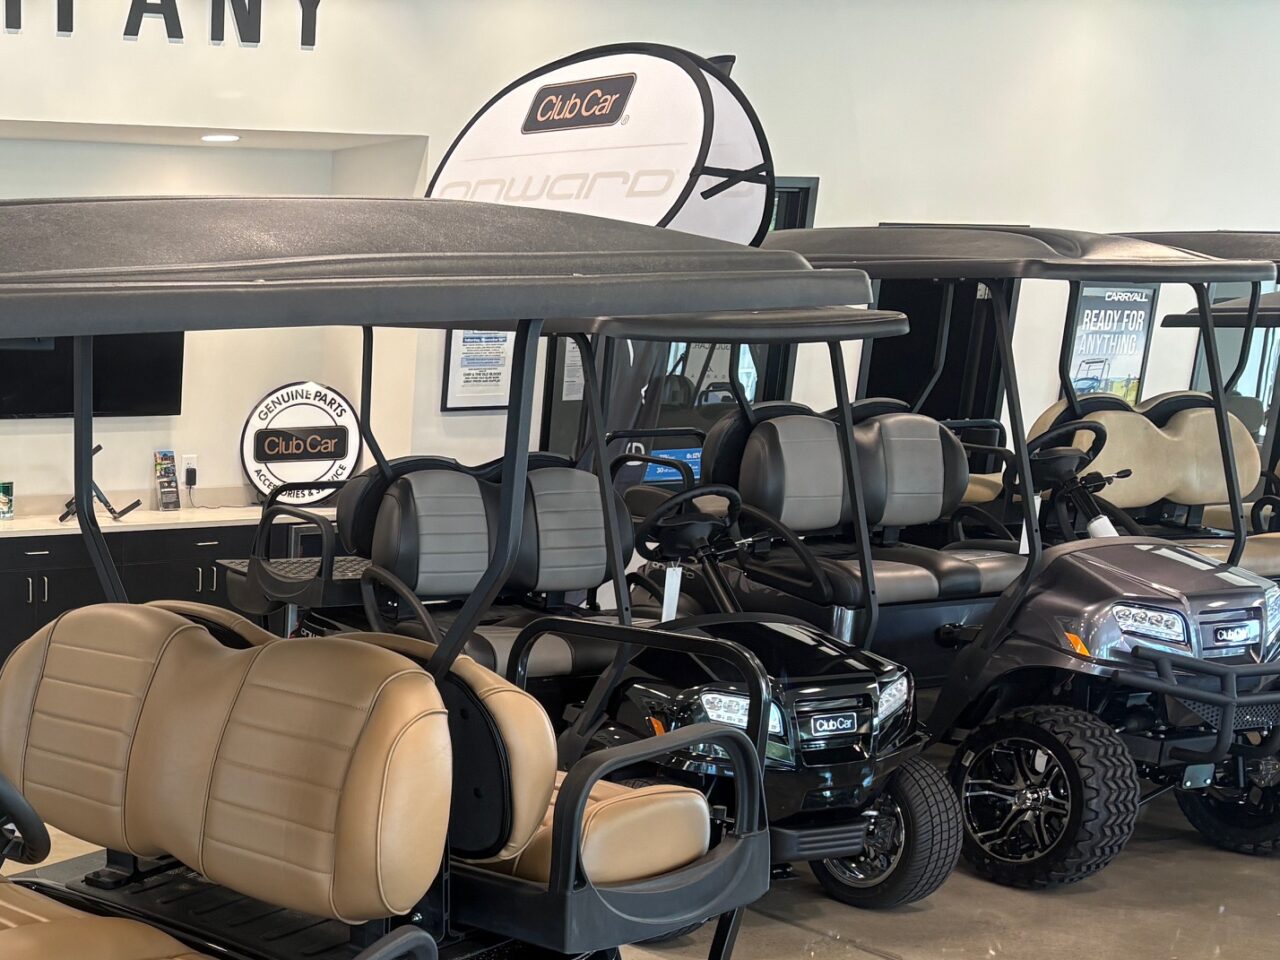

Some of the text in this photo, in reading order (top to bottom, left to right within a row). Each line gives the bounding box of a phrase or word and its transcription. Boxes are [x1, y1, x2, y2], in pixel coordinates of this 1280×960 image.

[537, 89, 620, 122] Club Car
[1105, 291, 1148, 302] CARRYALL
[1082, 309, 1145, 332] READY FOR
[258, 389, 347, 421] GENUINE PARTS
[264, 434, 338, 455] Club Car
[254, 469, 306, 499] ACCESORIES
[816, 717, 853, 731] Club Car
